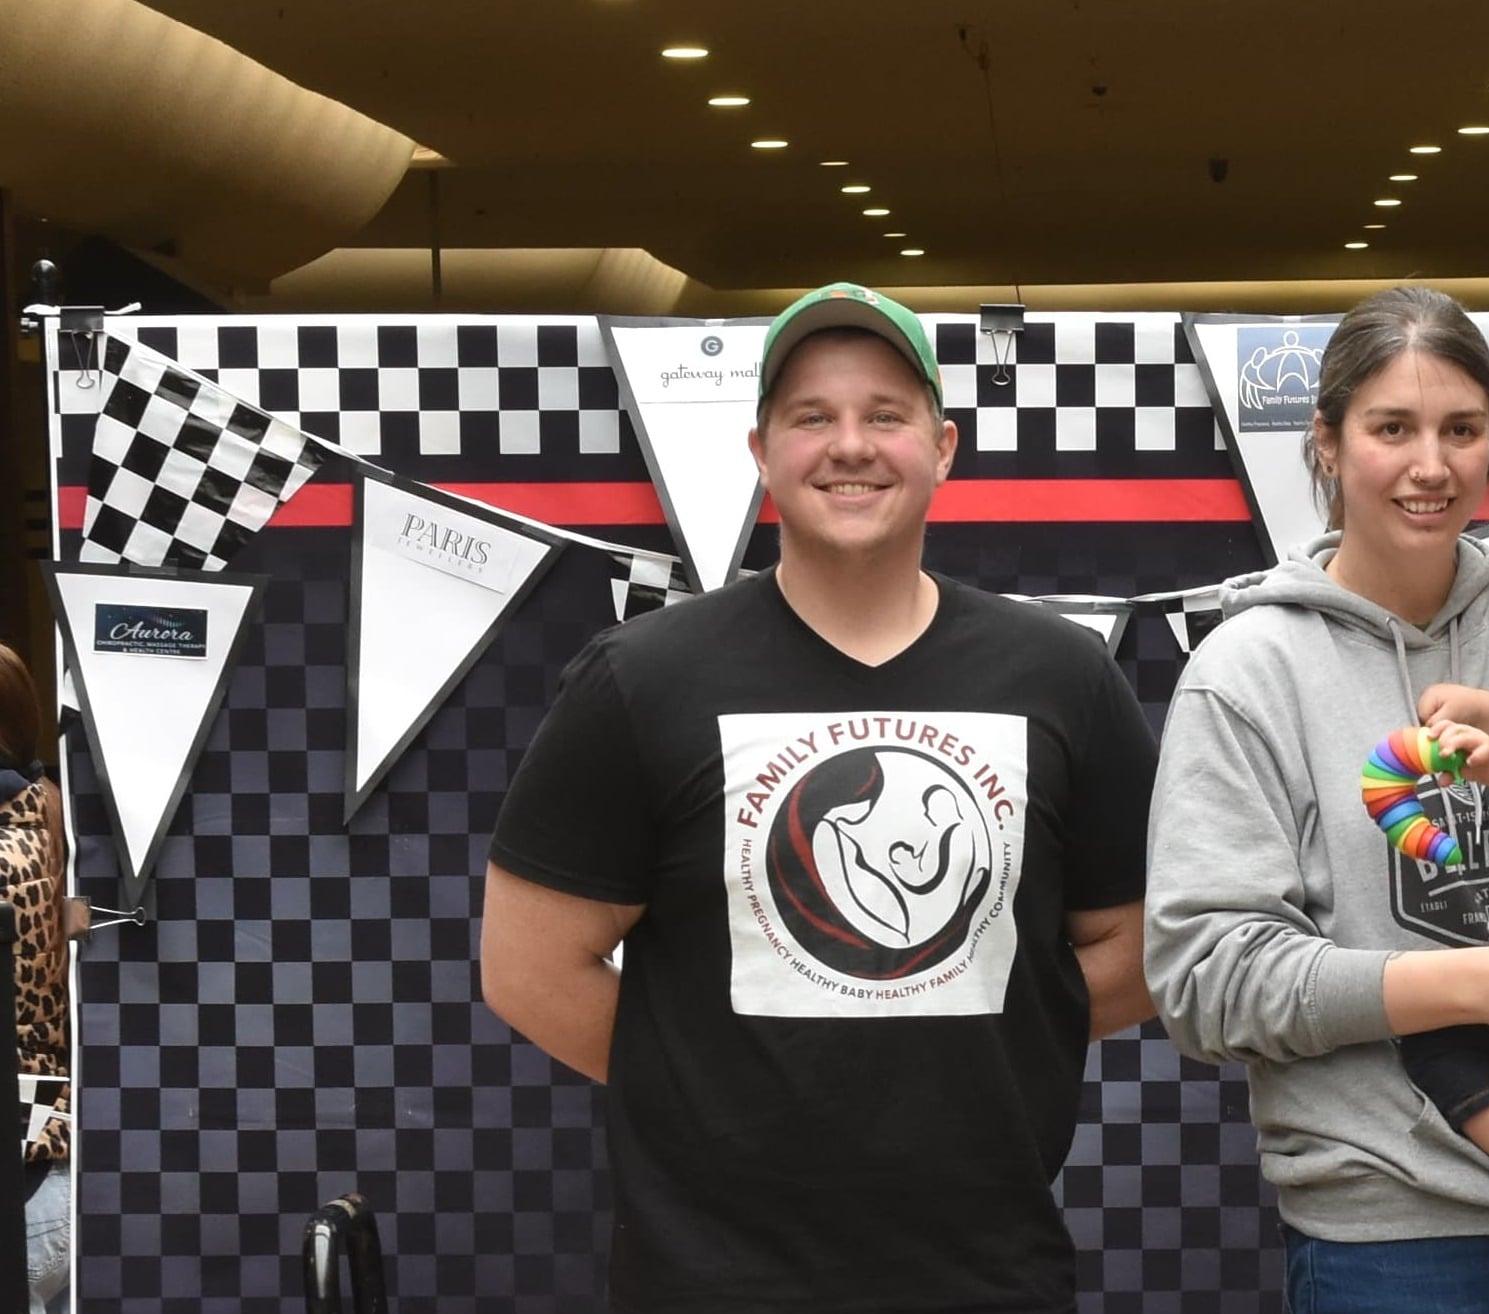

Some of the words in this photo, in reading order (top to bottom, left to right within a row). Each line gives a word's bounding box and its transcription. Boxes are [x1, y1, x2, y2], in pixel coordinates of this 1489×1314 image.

[660, 363, 723, 388] gateway
[401, 513, 492, 565] PARIS
[110, 620, 194, 641] Aurora
[737, 731, 819, 829] FAMILY
[827, 717, 976, 767] FUTURES
[973, 763, 1015, 831] INC.
[740, 838, 756, 892] HEALTHY
[988, 842, 1012, 919] COMMUNITY
[747, 894, 793, 960] PREGNANCY
[790, 957, 841, 993] HEALTHY
[840, 984, 875, 1000] BABY
[875, 983, 928, 1000] HEALTHY
[929, 959, 970, 989] FAMILY
